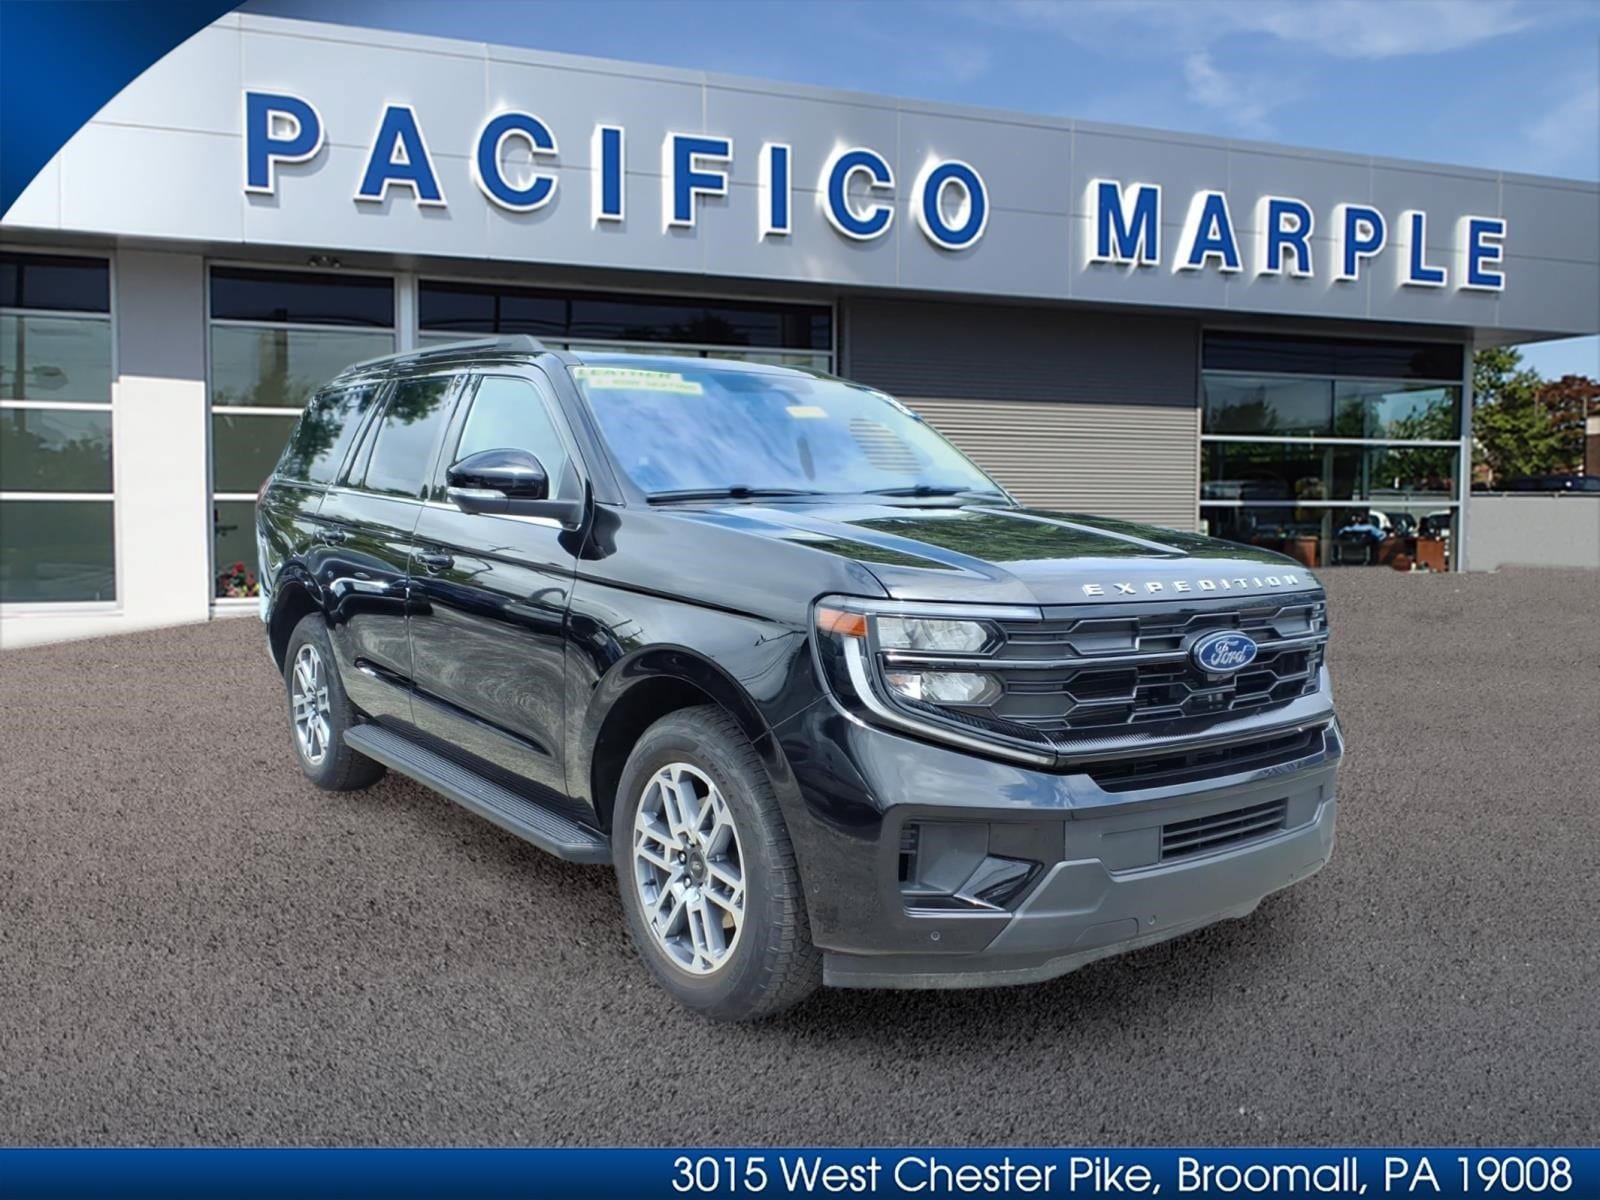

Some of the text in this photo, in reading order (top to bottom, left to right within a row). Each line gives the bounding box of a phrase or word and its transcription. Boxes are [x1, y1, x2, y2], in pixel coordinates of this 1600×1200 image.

[244, 90, 1507, 292] PACIFICO MARPLE
[1082, 573, 1300, 597] EXPEDITION
[1206, 637, 1251, 667] Ford
